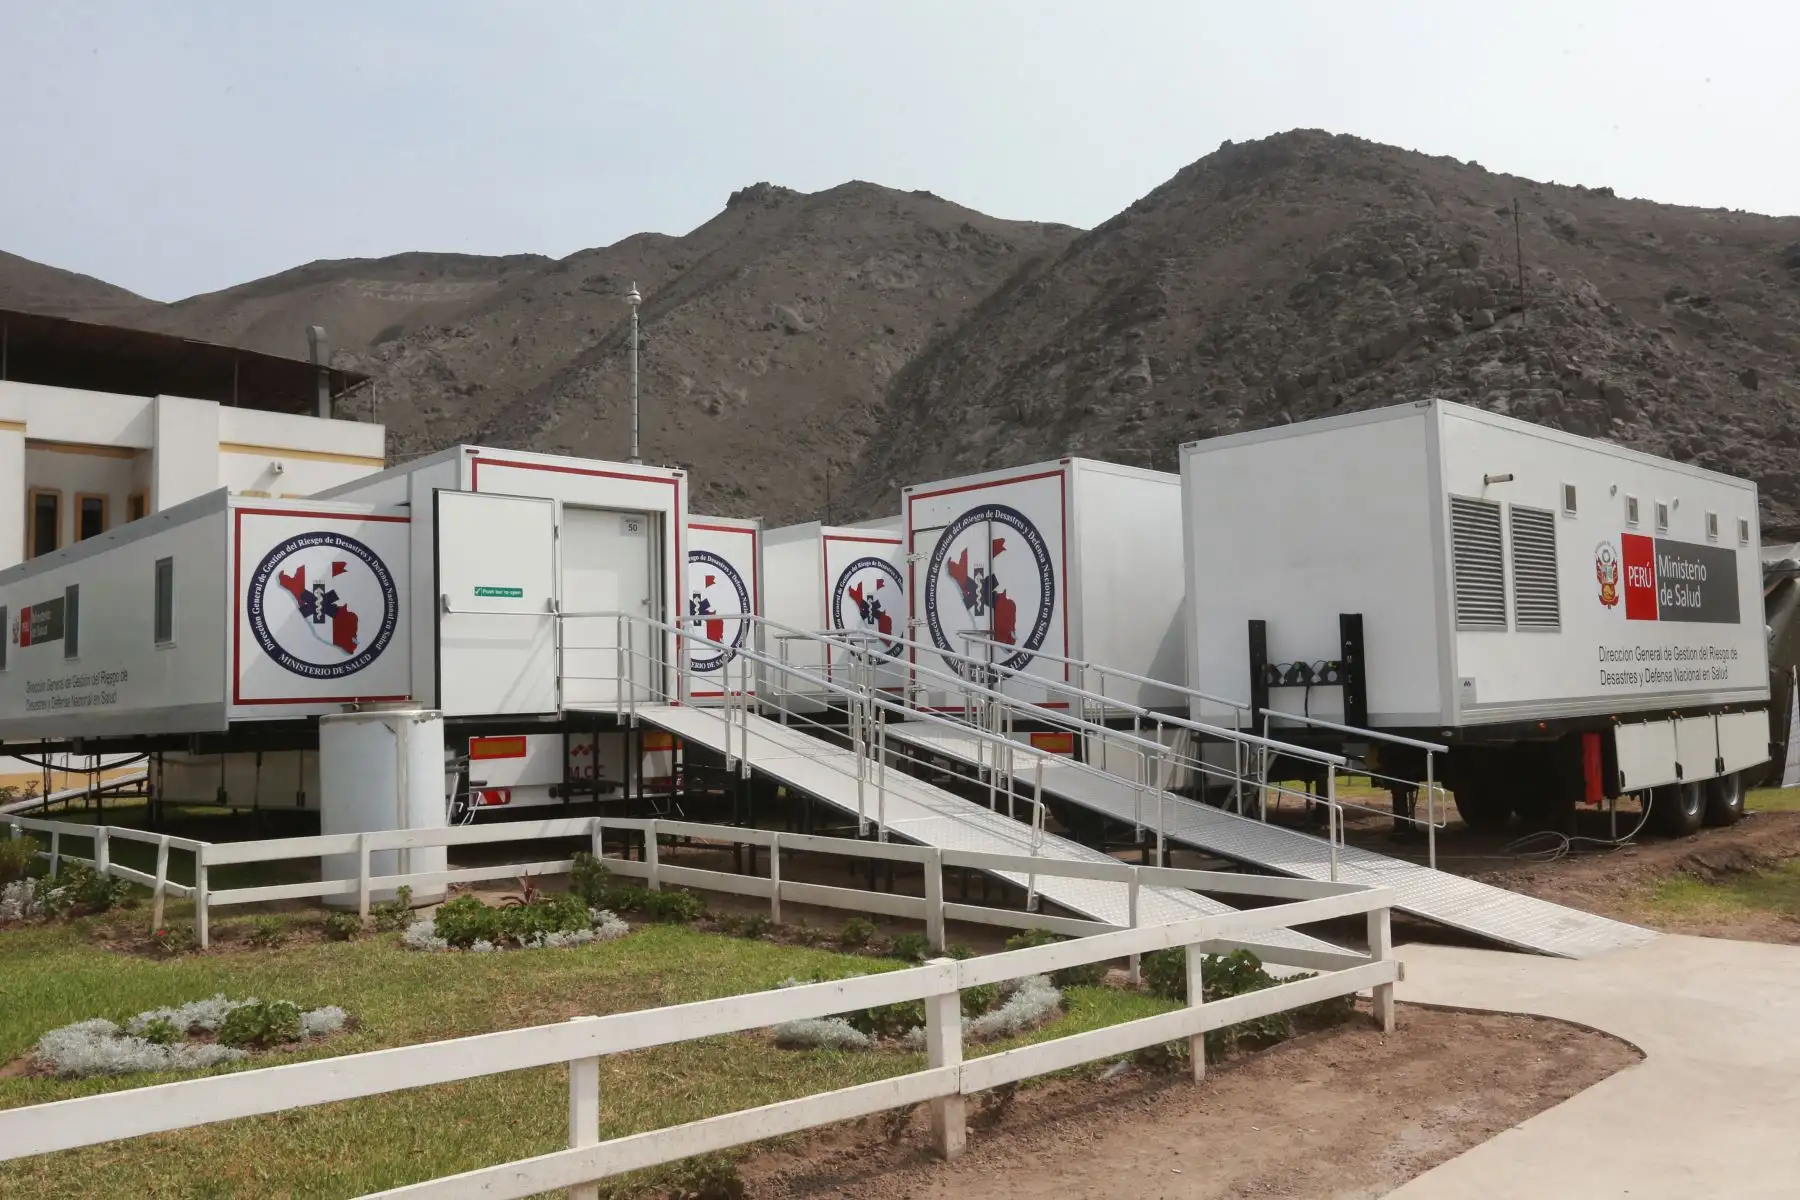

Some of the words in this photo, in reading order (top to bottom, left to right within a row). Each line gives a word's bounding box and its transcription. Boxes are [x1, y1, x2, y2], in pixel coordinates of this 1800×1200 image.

[962, 512, 985, 527] Riesgo
[985, 509, 994, 518] de
[995, 509, 1024, 530] Desastres
[628, 523, 638, 532] 50
[952, 524, 962, 535] del
[286, 542, 298, 553] del
[298, 537, 323, 547] Riesgo
[325, 536, 334, 544] de
[335, 537, 368, 558] Desastres
[1028, 530, 1046, 563] Defensa
[263, 550, 287, 573] Gestion
[932, 563, 939, 574] de
[1657, 554, 1707, 582] Ministerio
[258, 573, 267, 583] de
[371, 560, 389, 587] Defensa
[1628, 561, 1652, 588] PERÚ
[928, 575, 936, 610] General
[1042, 564, 1052, 606] Nacional
[1660, 582, 1673, 606] de
[1674, 583, 1702, 608] Salud
[252, 583, 263, 615] General
[386, 587, 396, 620] Nacional
[1042, 607, 1049, 618] en
[255, 616, 276, 651] Direccion
[385, 620, 392, 630] en
[1032, 620, 1047, 647] Salud
[375, 630, 391, 650] Salud
[278, 653, 331, 676] MINISTERIO
[332, 667, 345, 675] DE
[345, 653, 372, 672] SALUD
[1599, 645, 1634, 662] Direccion
[1635, 645, 1663, 661] General
[1663, 646, 1672, 661] de
[1673, 645, 1698, 661] Gestion
[1699, 646, 1709, 660] del
[1709, 646, 1730, 664] Riesgo
[1730, 647, 1738, 660] de
[1600, 669, 1638, 686] Desastres
[1638, 672, 1644, 687] y
[1644, 667, 1673, 683] Defensa
[1673, 667, 1701, 682] Nacional
[1702, 669, 1710, 681] en
[1711, 666, 1728, 680] Salud
